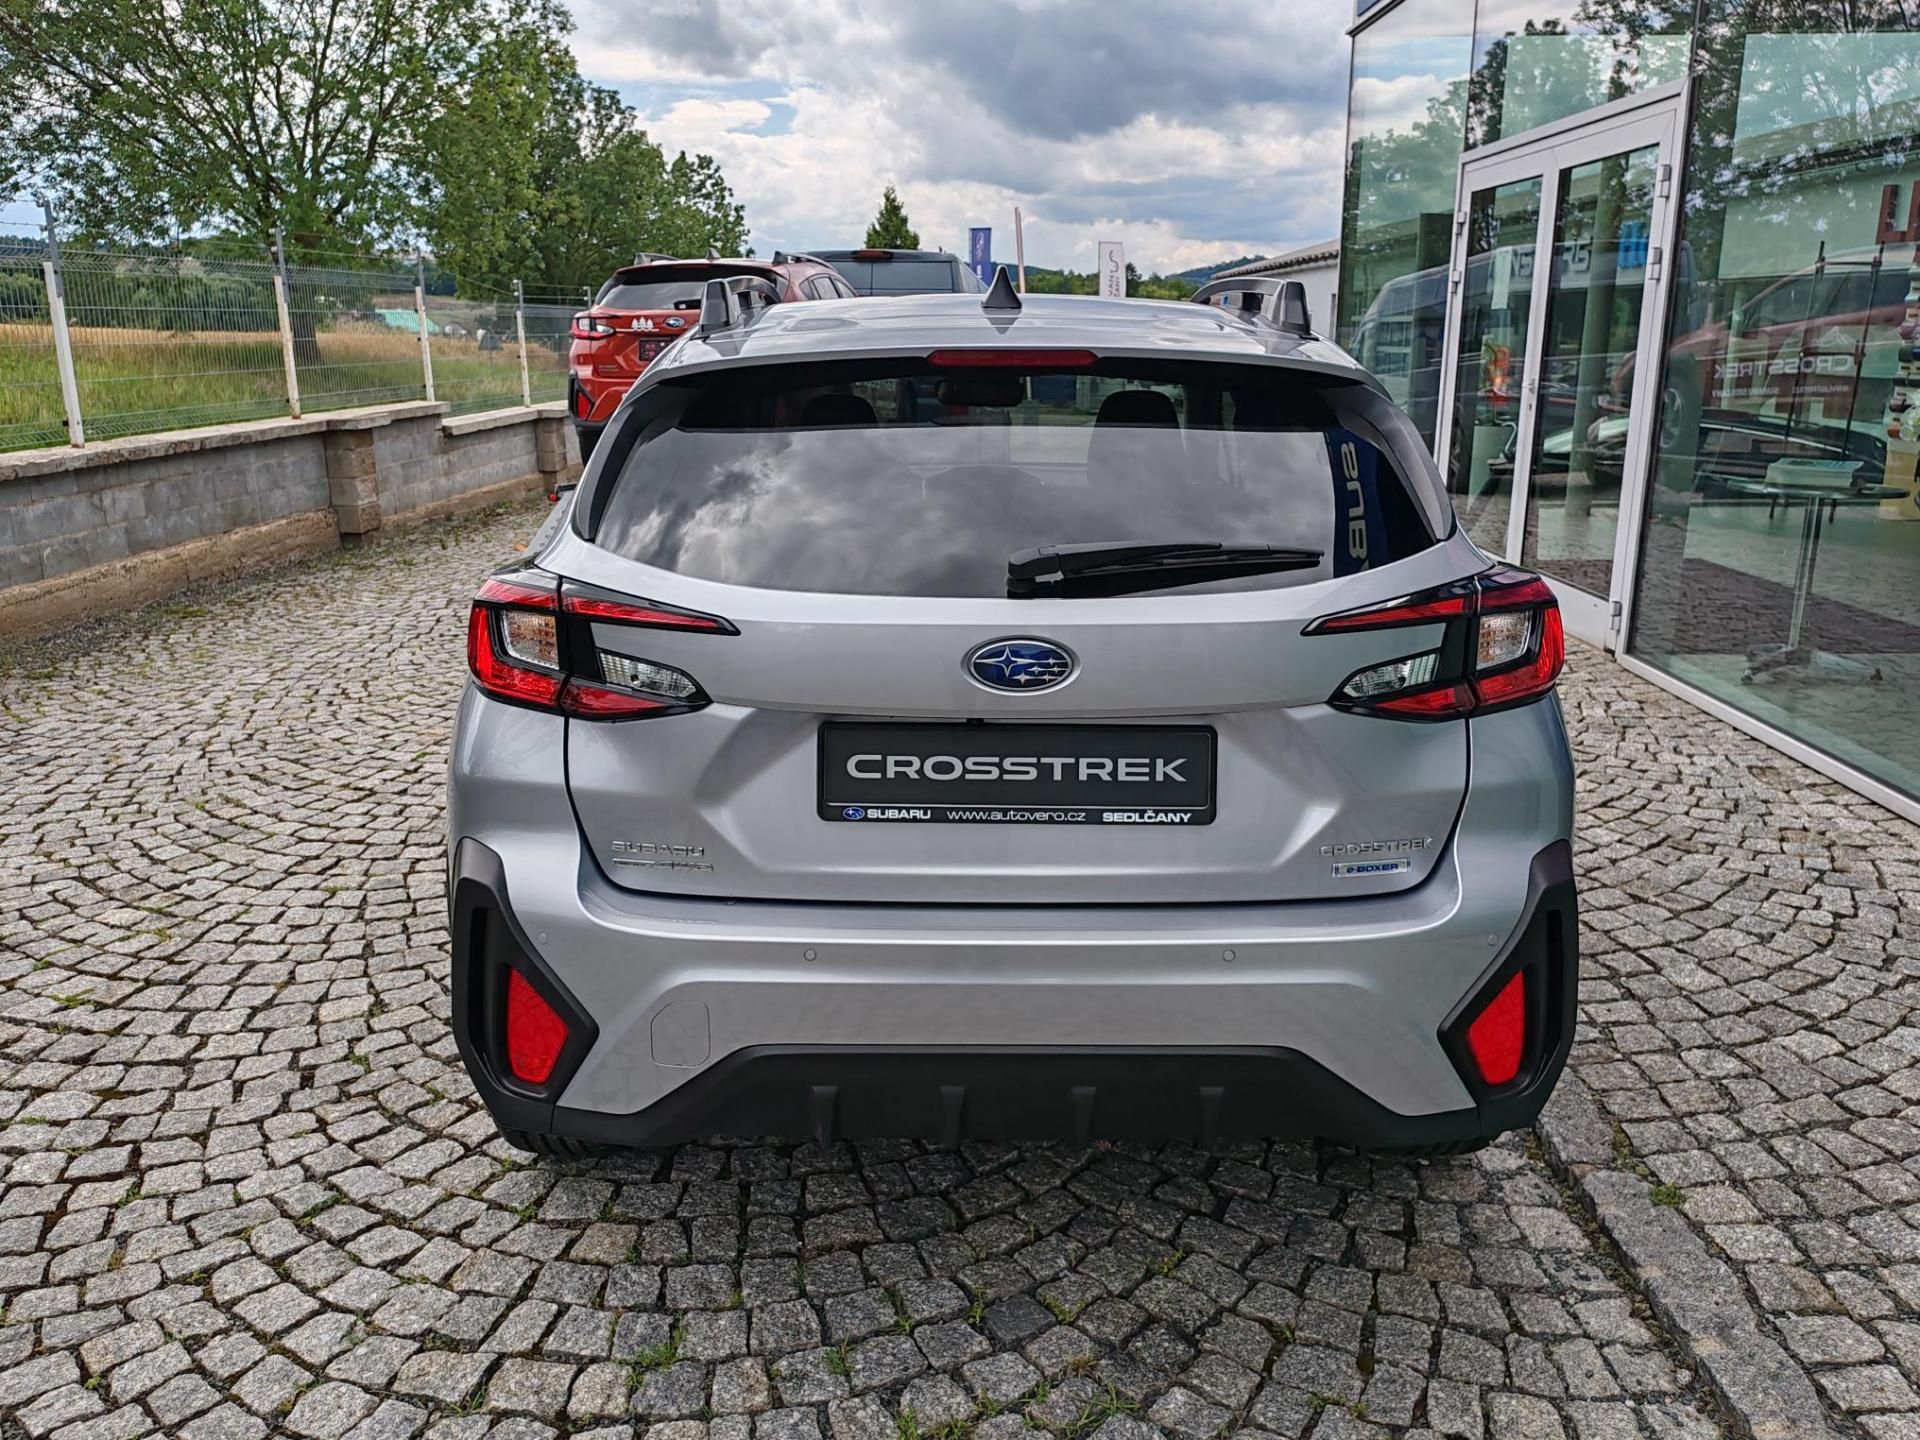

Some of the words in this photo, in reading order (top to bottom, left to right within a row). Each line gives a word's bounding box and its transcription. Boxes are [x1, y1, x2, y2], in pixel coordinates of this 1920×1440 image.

[846, 754, 1188, 783] CROSSTREK
[866, 808, 932, 820] SUBARU
[946, 809, 1087, 822] www.autovero.cz
[1102, 810, 1192, 824] SEDLČANY
[1319, 838, 1433, 856] CROSSTREK
[1346, 863, 1399, 874] e-BOXER
